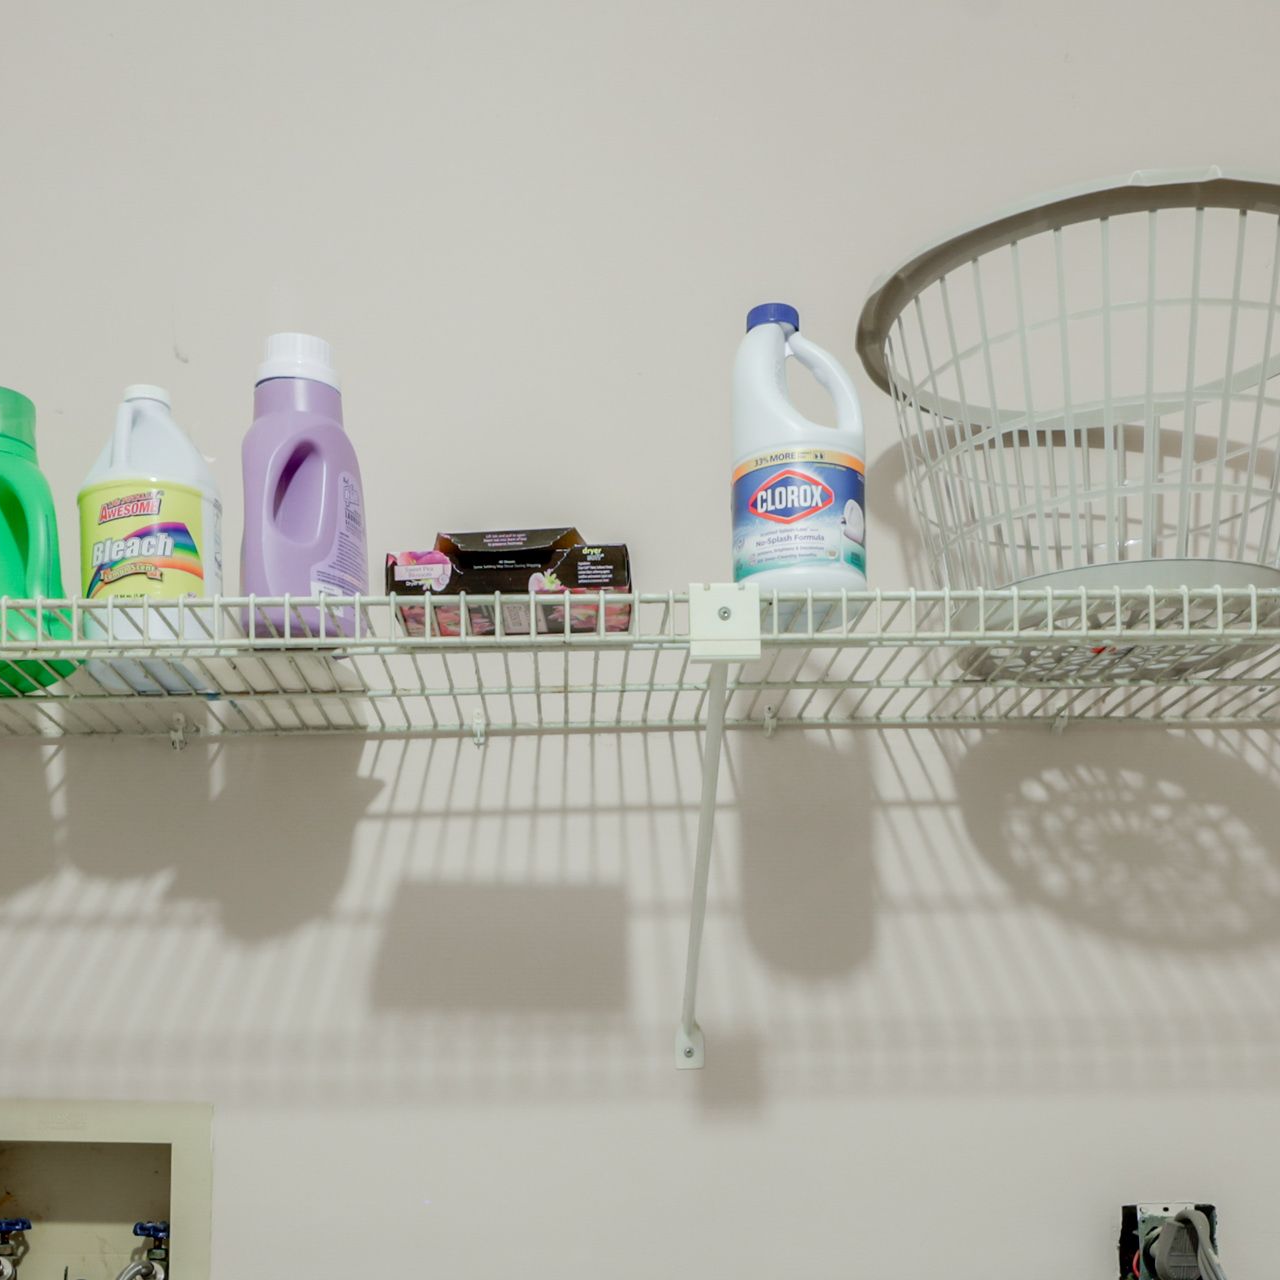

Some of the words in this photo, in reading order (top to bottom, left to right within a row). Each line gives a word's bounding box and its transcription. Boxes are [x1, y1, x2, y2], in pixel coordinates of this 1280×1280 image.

[769, 452, 795, 462] MORE
[756, 485, 823, 513] CLOROX
[99, 500, 159, 522] AWESOME
[92, 533, 175, 568] Bleach
[582, 547, 602, 555] dryer
